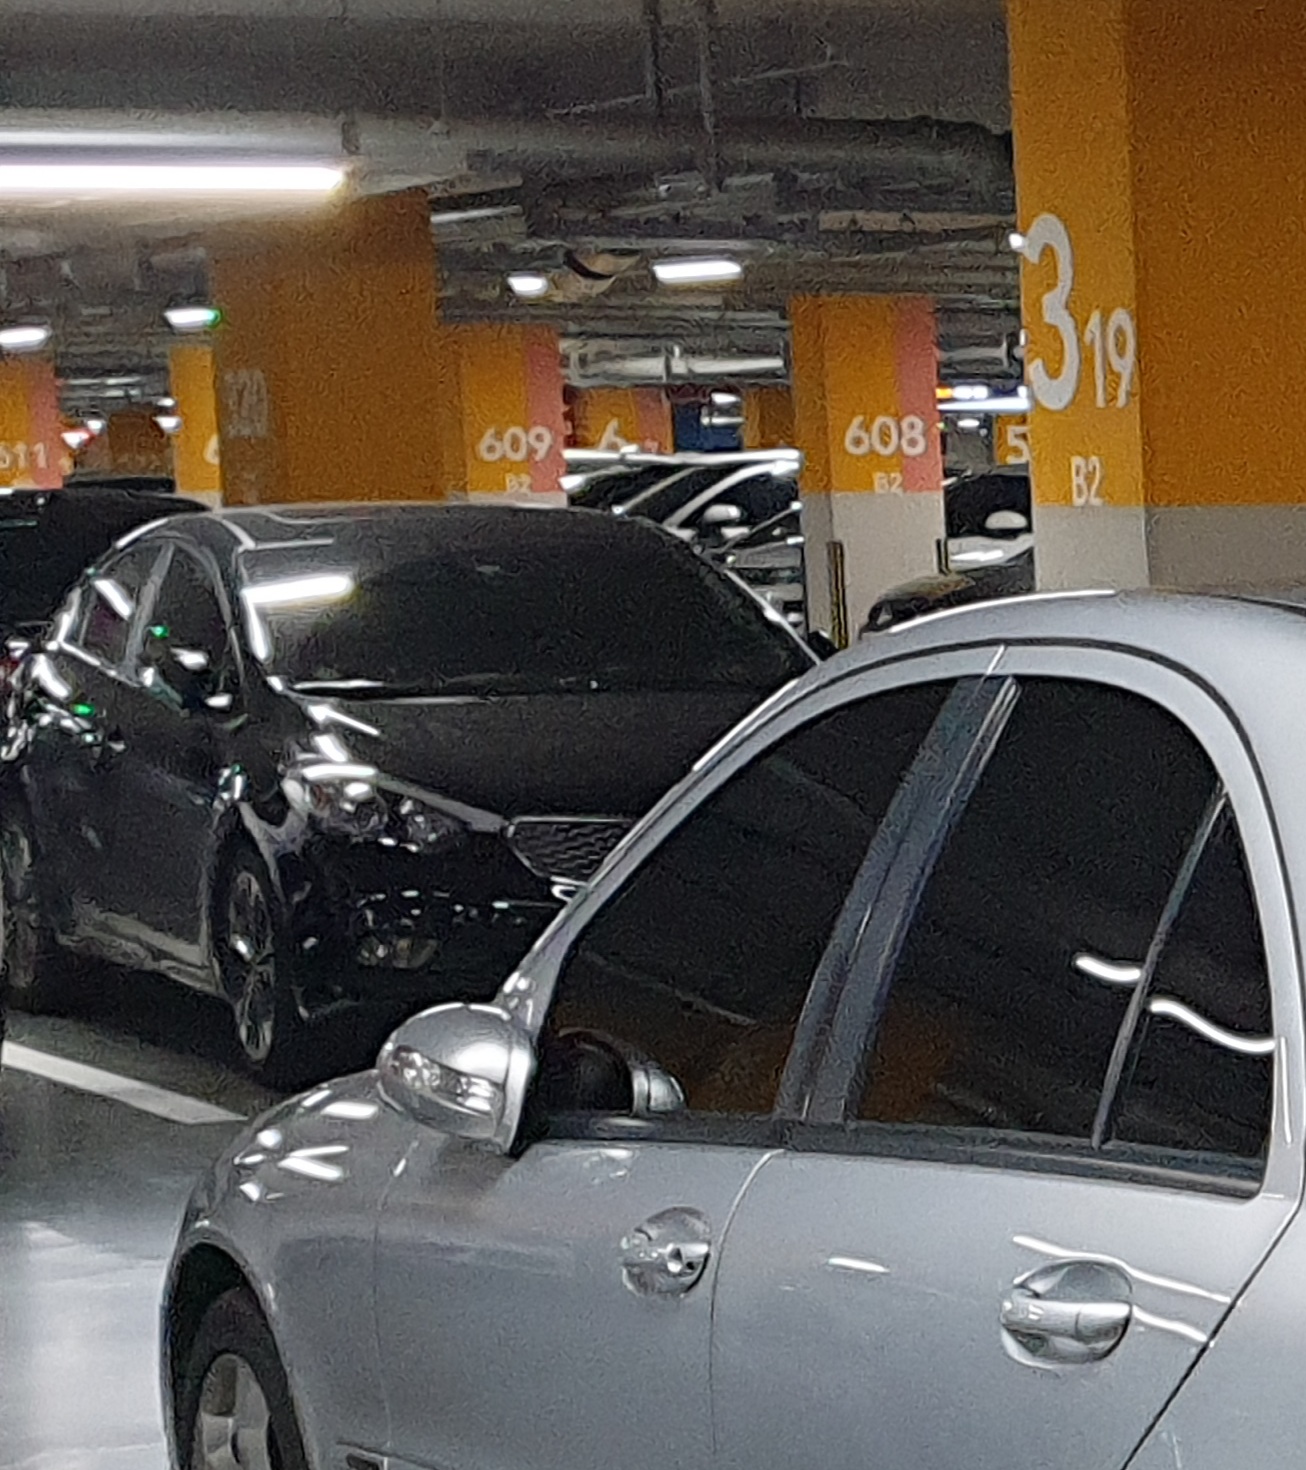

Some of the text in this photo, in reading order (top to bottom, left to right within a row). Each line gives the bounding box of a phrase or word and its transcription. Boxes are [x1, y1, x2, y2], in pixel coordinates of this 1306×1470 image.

[478, 426, 553, 462] 609
[845, 415, 926, 456] 608
[1071, 456, 1104, 506] B2
